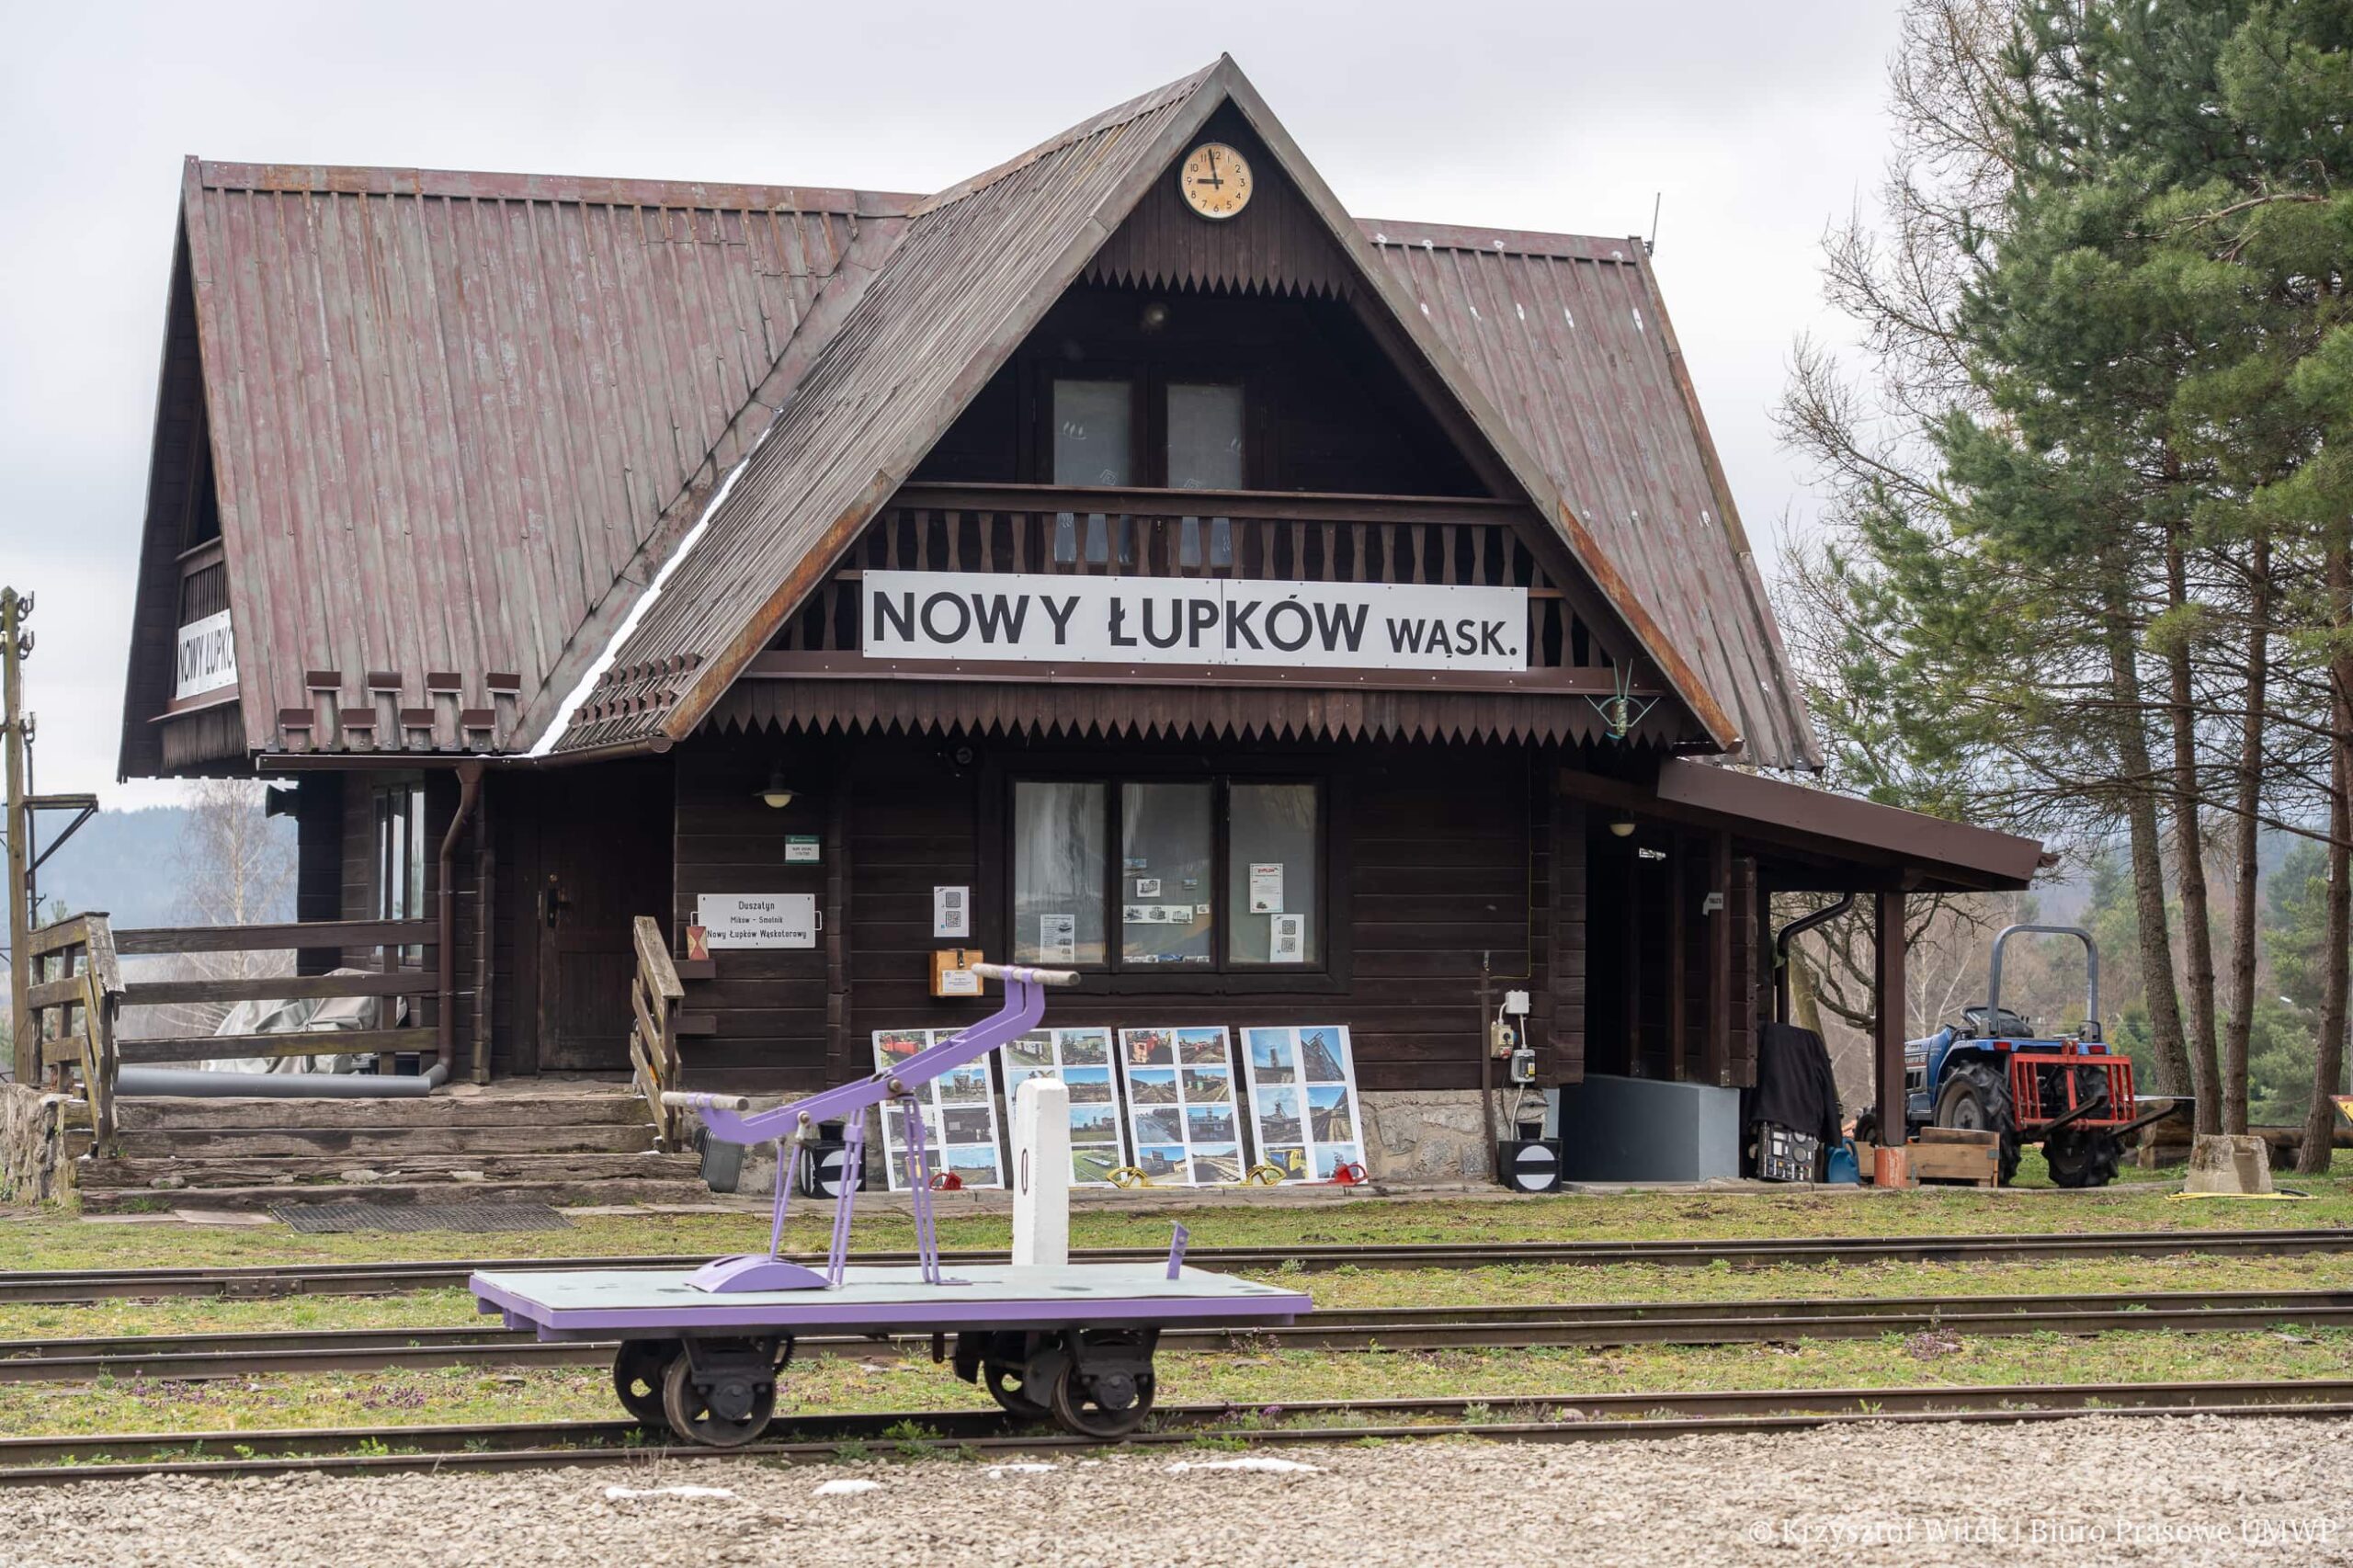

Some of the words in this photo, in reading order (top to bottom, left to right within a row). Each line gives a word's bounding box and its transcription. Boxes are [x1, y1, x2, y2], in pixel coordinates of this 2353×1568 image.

[1190, 164, 1199, 172] 10
[1235, 165, 1241, 173] 2
[1187, 176, 1192, 185] 9
[1240, 178, 1245, 187] 3
[873, 591, 1081, 644] NOWY
[1108, 594, 1370, 653] ŁUPKÓW
[1386, 618, 1518, 658] WĄSK.
[178, 634, 204, 685] NOWY
[738, 901, 775, 912] Duszatyn
[707, 930, 726, 939] Nowy
[729, 929, 757, 939] Łupków
[759, 929, 807, 939] Wąskotorowy
